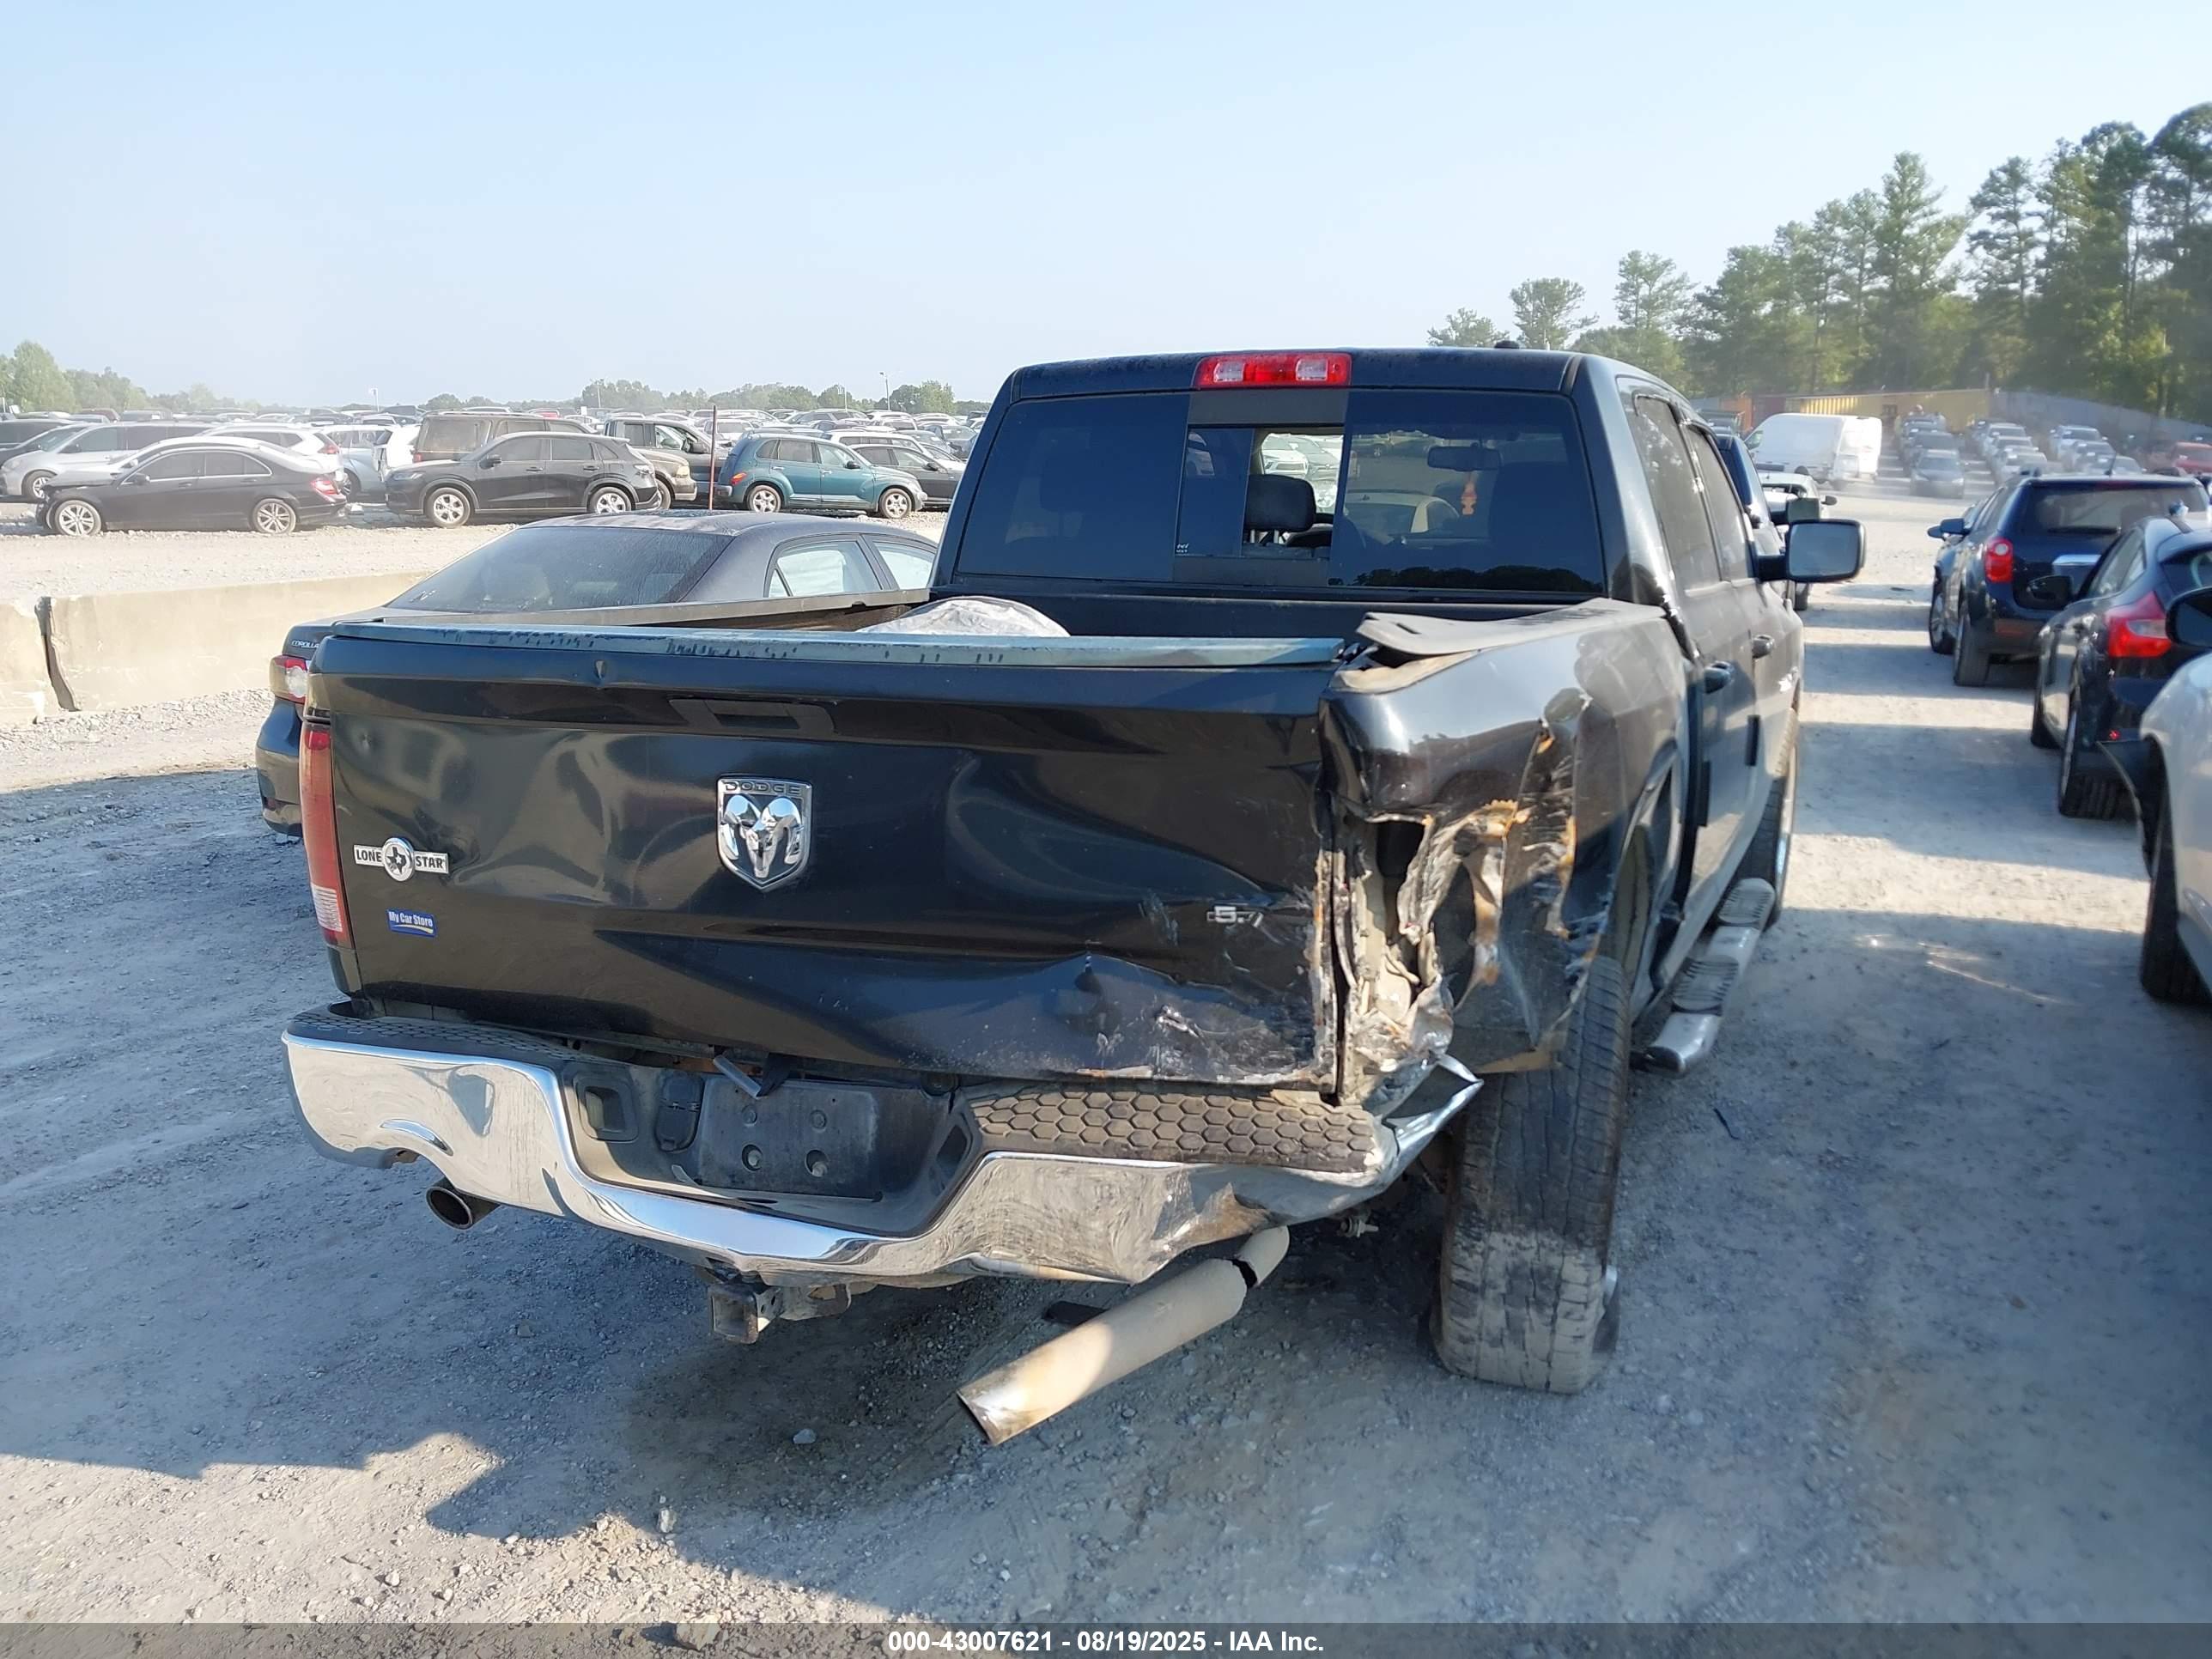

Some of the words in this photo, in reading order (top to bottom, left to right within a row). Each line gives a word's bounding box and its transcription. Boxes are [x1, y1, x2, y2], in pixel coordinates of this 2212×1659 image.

[722, 781, 803, 795] DODGE
[356, 848, 381, 863] LONE
[416, 855, 443, 869] STAR
[388, 911, 399, 923] My
[399, 912, 412, 924] Car
[412, 914, 434, 927] Store
